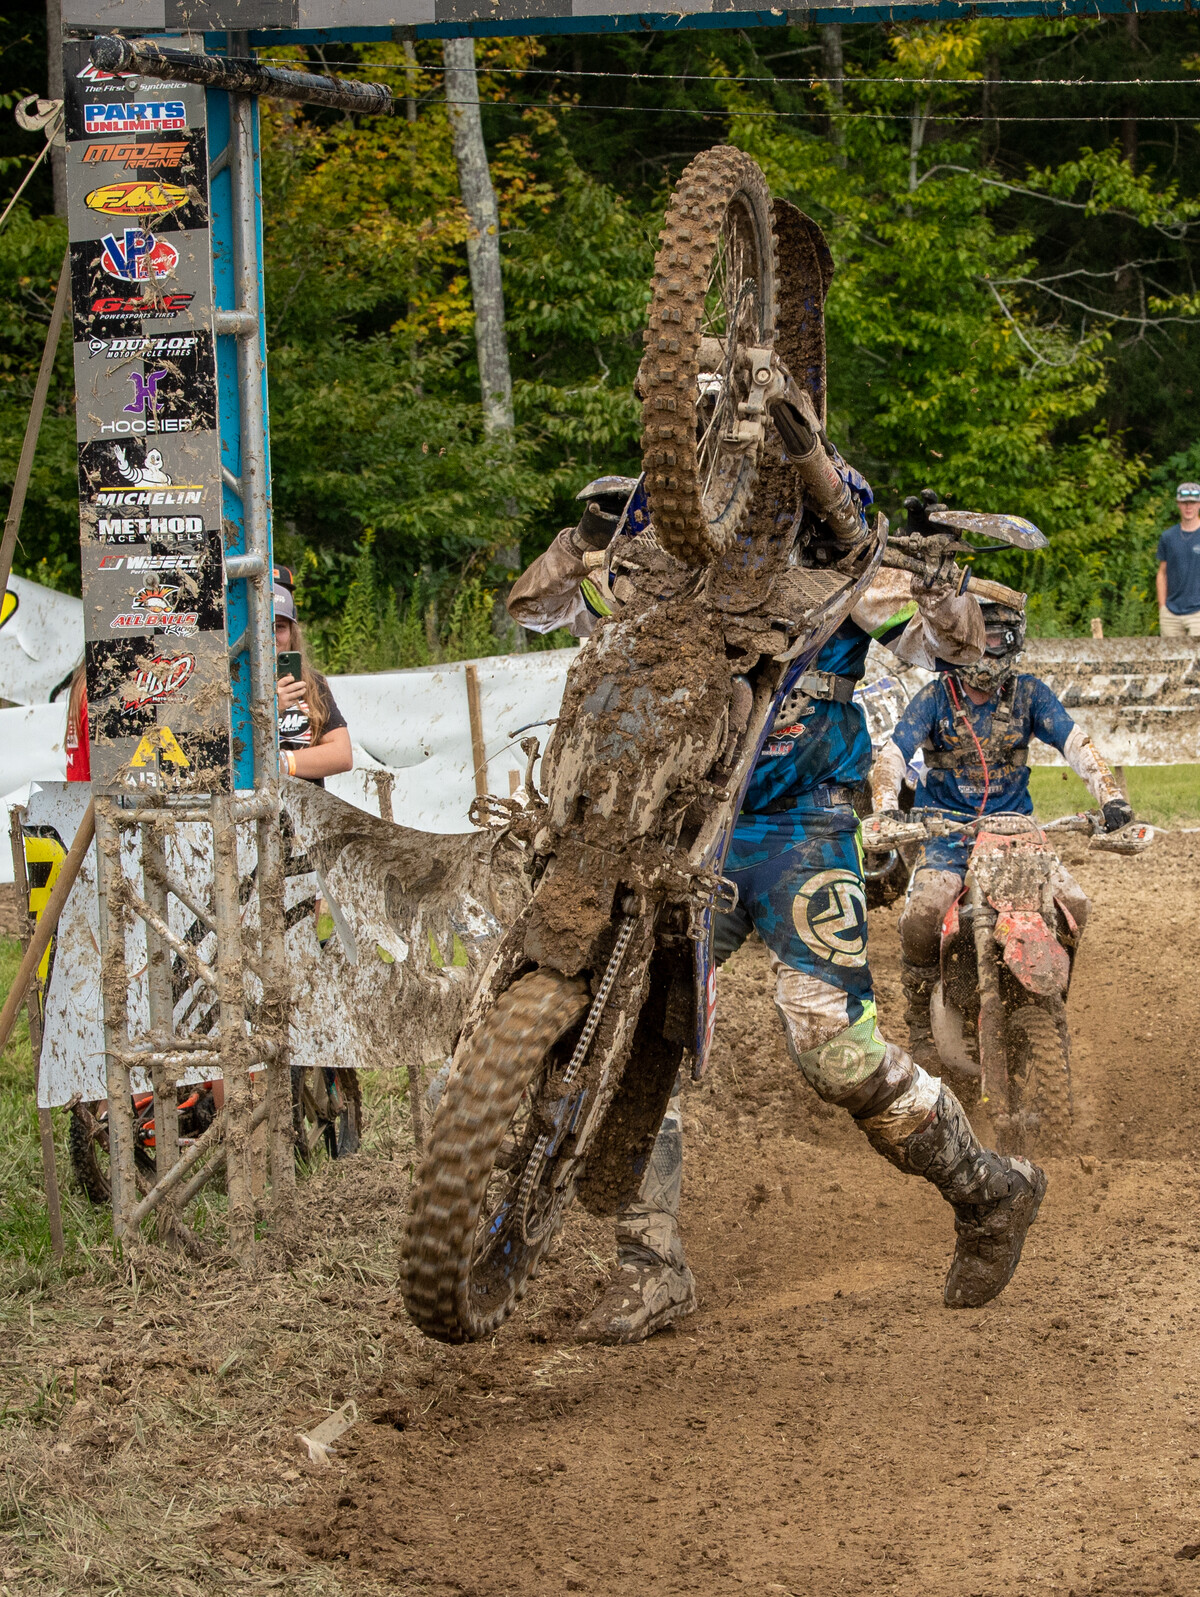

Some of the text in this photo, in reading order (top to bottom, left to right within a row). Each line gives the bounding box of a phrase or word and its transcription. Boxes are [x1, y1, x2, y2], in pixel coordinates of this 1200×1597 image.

[103, 84, 125, 92] First
[139, 82, 187, 91] Synthetics
[85, 101, 185, 121] PARTS
[86, 118, 185, 132] UNLIMITED
[82, 142, 189, 161] MOOSE
[124, 159, 180, 169] RACING
[87, 185, 188, 208] FMF
[101, 228, 155, 280] VP
[109, 338, 198, 351] DUNLOP
[106, 349, 191, 358] MOTORYCLE TIRES
[101, 419, 192, 433] HOOSIER
[96, 491, 202, 506] MICHELIN
[98, 517, 203, 535] METHOD
[112, 613, 198, 627] ALL BALLS
[165, 625, 199, 637] Racing
